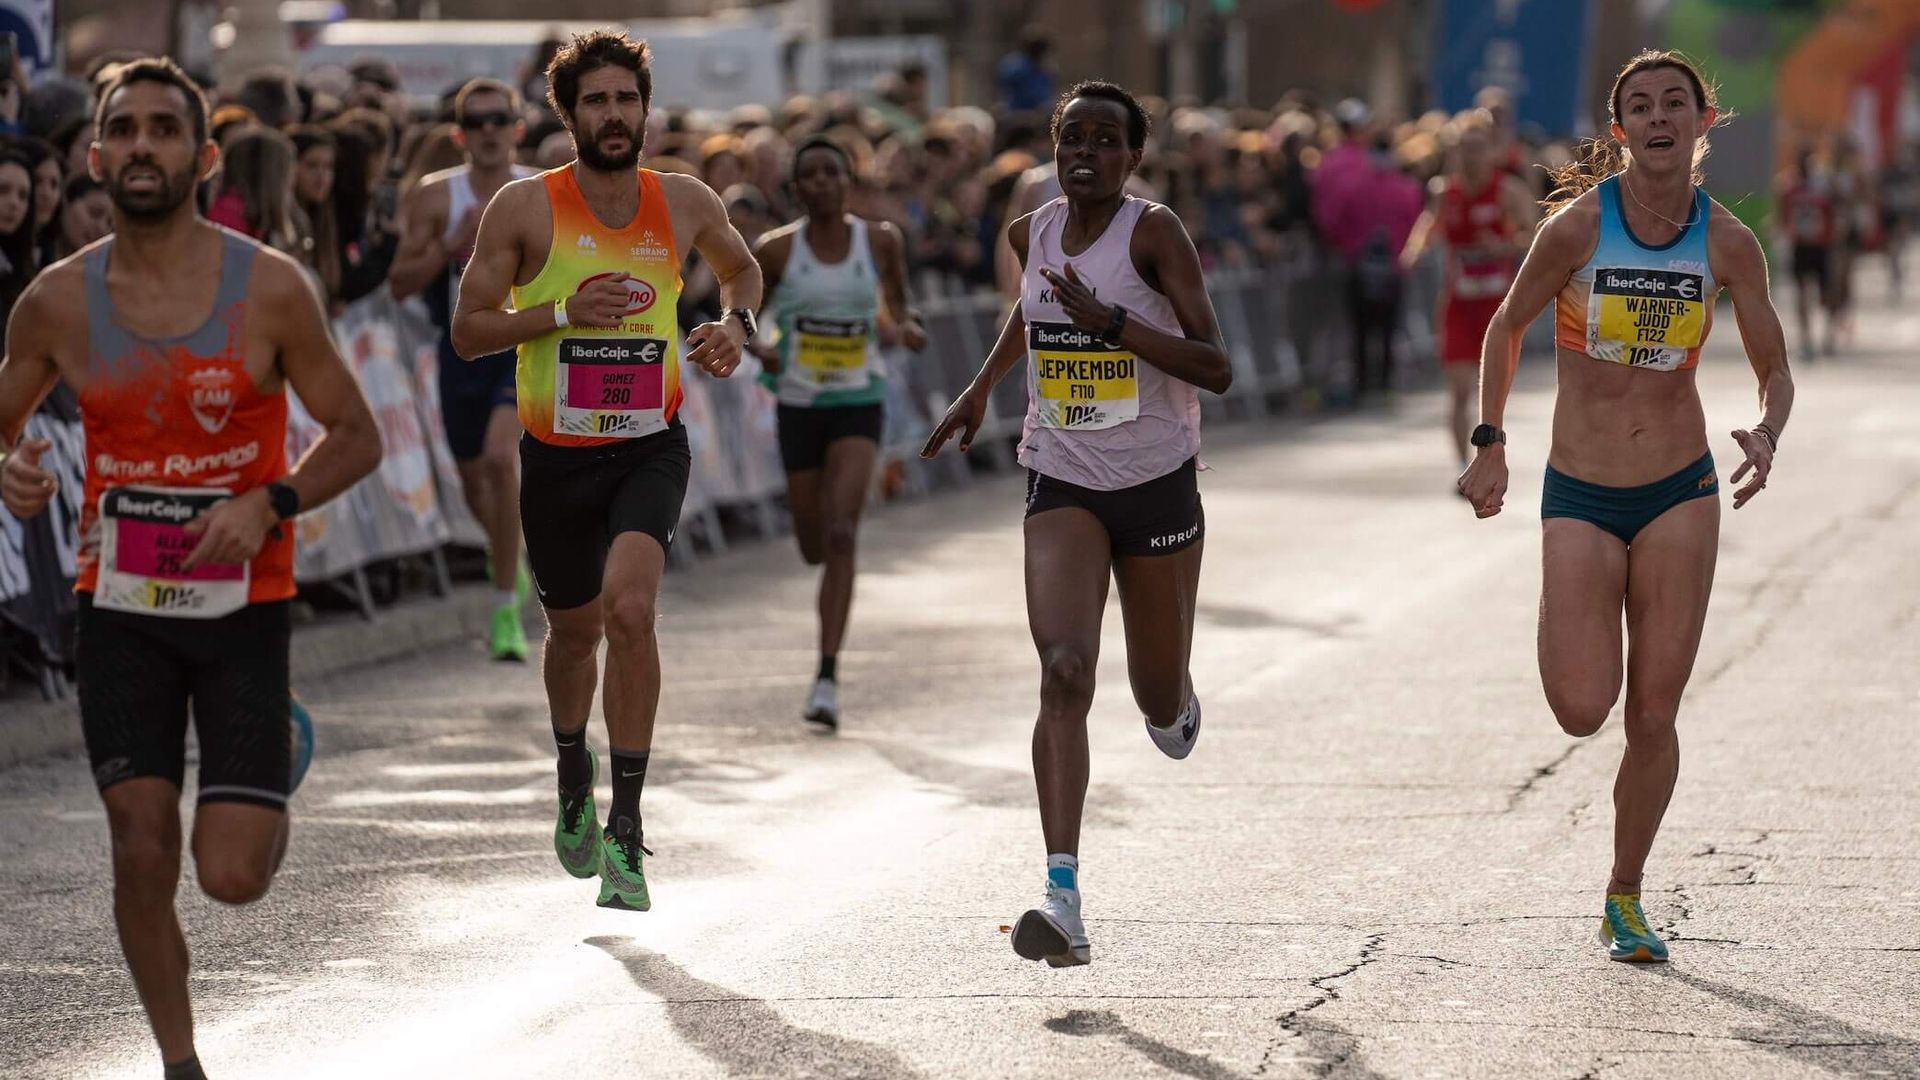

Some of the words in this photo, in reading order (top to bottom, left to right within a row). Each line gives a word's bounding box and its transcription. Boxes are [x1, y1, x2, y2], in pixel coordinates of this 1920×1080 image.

[630, 247, 669, 257] SERRANO
[1606, 275, 1666, 293] iberCaja
[1626, 297, 1691, 316] WARNER-
[629, 322, 654, 335] CORRE
[1634, 313, 1671, 329] JUDD
[1038, 329, 1091, 347] iberCaja
[1636, 328, 1666, 343] F122
[571, 345, 630, 361] iberCaja
[1629, 347, 1664, 366] 10K
[1039, 358, 1135, 381] JEPKEMBOI
[602, 373, 636, 385] GOMEZ
[601, 388, 631, 405] 280
[1070, 384, 1095, 399] F110
[598, 414, 632, 434] 10K
[1065, 405, 1097, 427] 10K
[117, 496, 192, 522] iberCaja
[1150, 522, 1198, 548] KIPRUN
